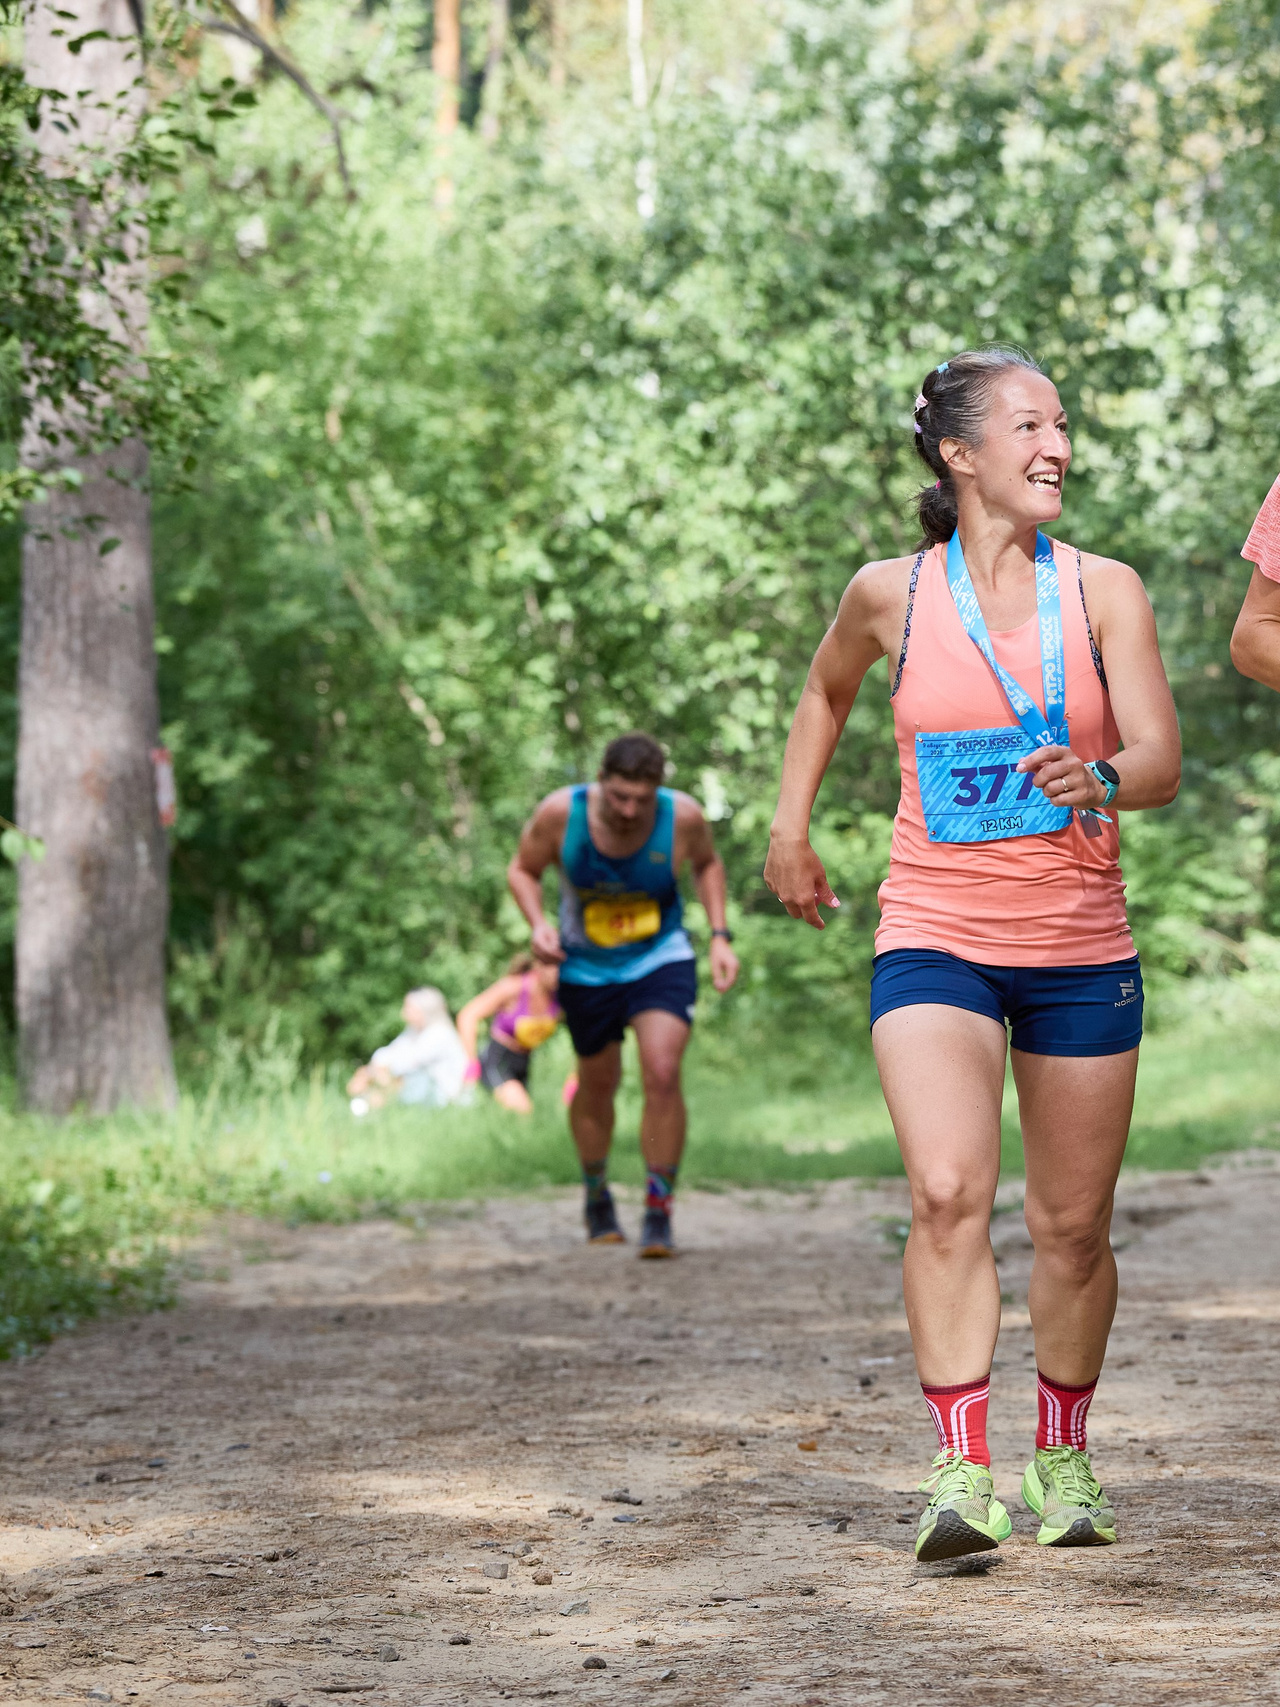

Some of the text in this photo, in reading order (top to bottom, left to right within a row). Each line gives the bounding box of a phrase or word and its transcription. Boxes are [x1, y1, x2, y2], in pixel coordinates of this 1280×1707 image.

[1041, 616, 1058, 705] РЕТРО КРОСС
[956, 735, 1023, 749] РЕТРО КРОСС
[1036, 730, 1054, 746] 12
[951, 763, 1037, 807] 377
[981, 819, 998, 832] 12
